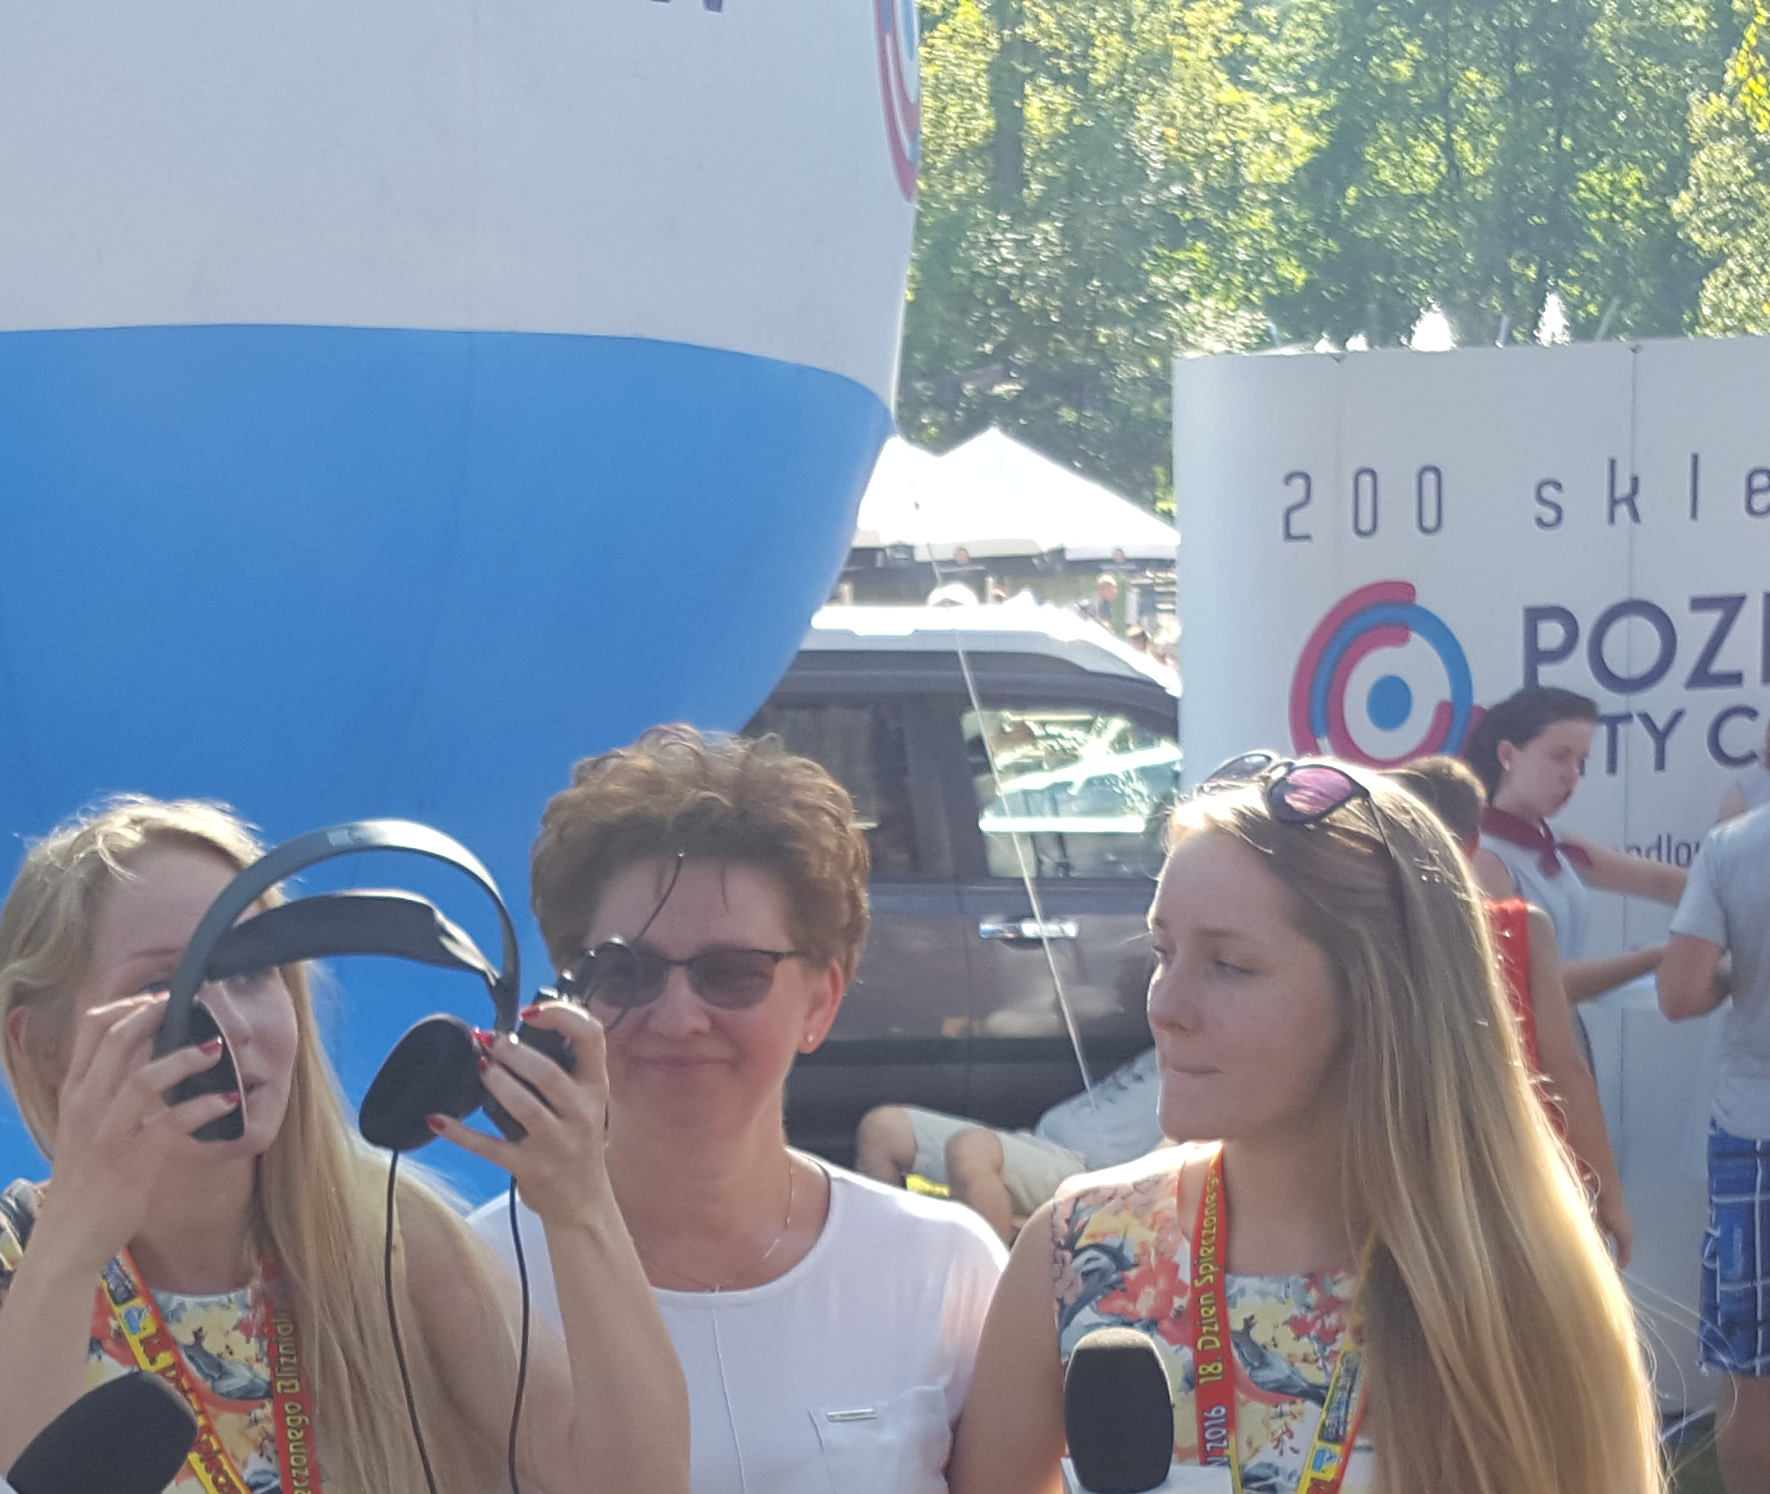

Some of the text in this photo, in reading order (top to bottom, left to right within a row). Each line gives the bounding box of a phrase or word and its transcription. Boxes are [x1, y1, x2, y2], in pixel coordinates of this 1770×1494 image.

[1282, 464, 1444, 542] 200
[1580, 708, 1687, 777] TY
[1197, 1355, 1225, 1386] 18.
[1200, 1403, 1229, 1450] 2016
